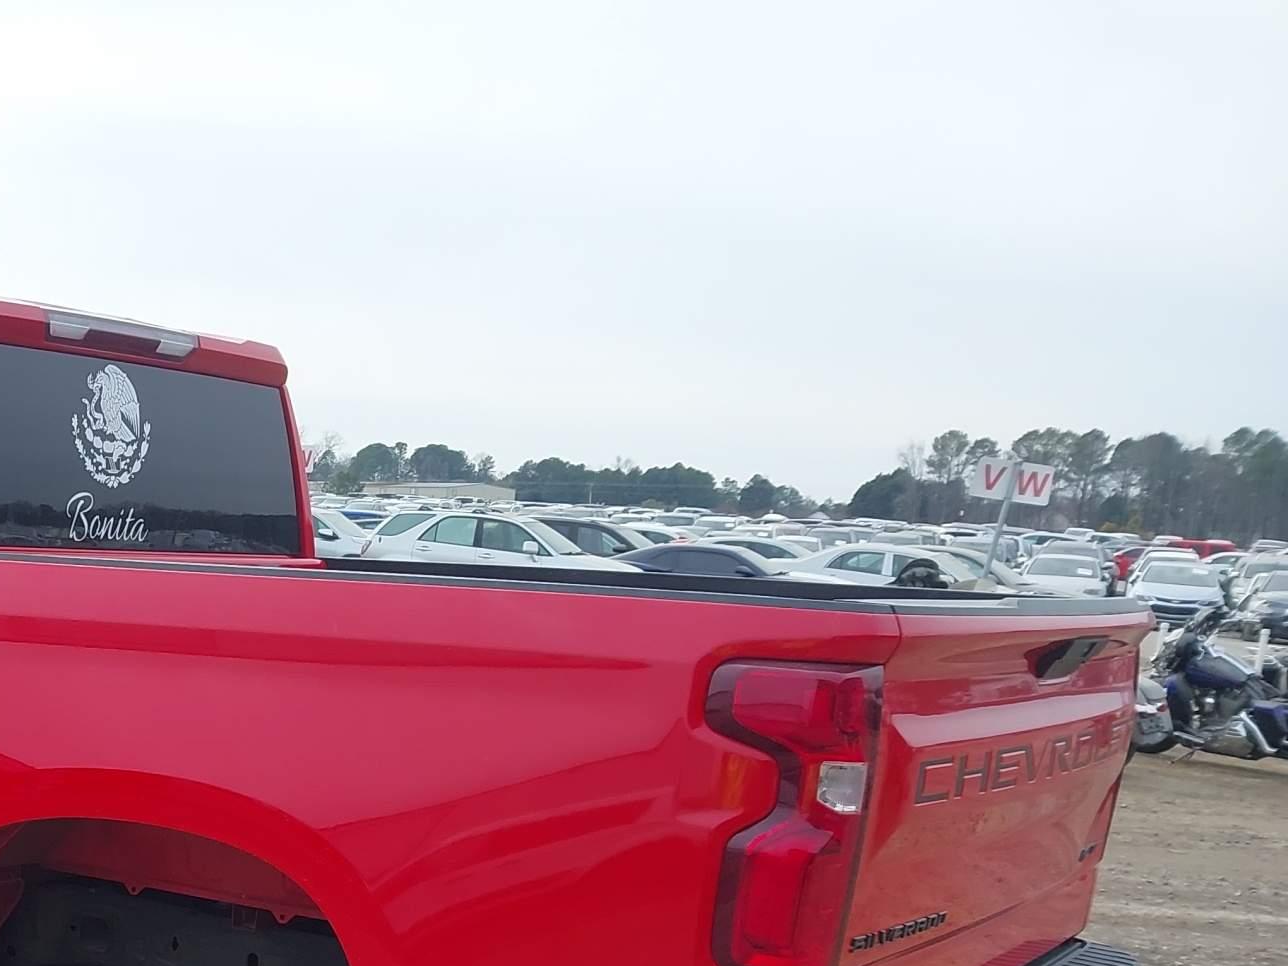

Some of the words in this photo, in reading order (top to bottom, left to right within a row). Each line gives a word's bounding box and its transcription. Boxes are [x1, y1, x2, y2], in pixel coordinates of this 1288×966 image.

[984, 463, 1008, 491] V
[1017, 469, 1051, 498] W
[66, 491, 149, 542] Bonita
